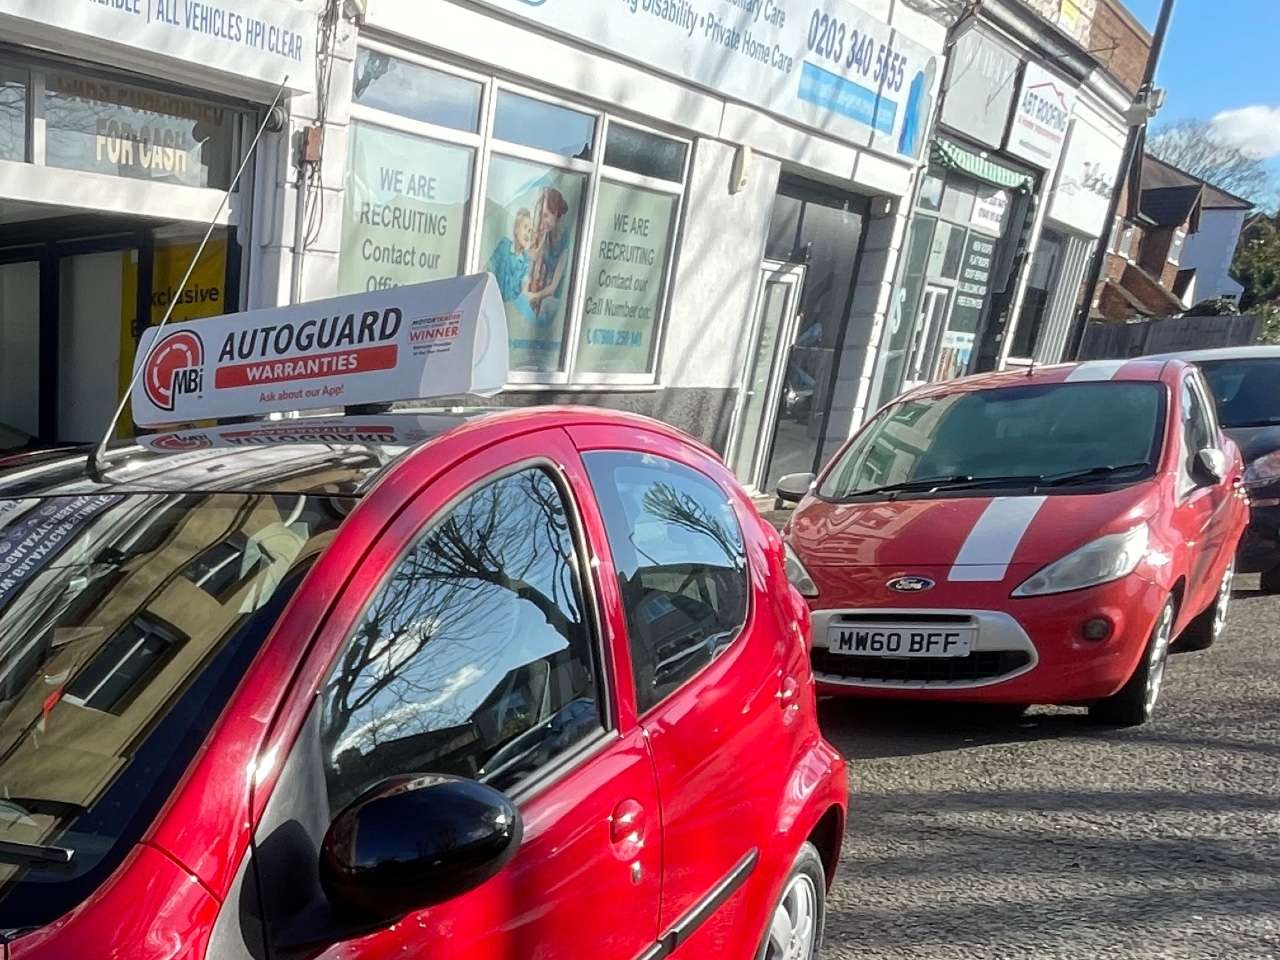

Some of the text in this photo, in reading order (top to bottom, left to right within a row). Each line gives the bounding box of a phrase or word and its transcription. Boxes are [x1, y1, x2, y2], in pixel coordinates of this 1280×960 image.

[157, 0, 180, 25] ALL
[185, 1, 242, 43] VEHICLES
[246, 18, 266, 50] HPI
[268, 26, 303, 61] CLEAR
[705, 12, 741, 51] Private
[741, 30, 771, 65] Home
[771, 44, 793, 74] Care
[807, 8, 846, 63] 0203
[846, 29, 874, 77] 340
[96, 119, 186, 172] FOR CASH
[379, 167, 437, 199] WE ARE
[360, 202, 448, 236] RECRUITING
[613, 213, 650, 237] WE ARE
[362, 238, 441, 270] Contact our
[599, 240, 655, 266] RECRUITING
[598, 269, 632, 291] Contact
[219, 307, 402, 363] AUTOGUARD
[410, 326, 459, 341] WINNER
[246, 355, 359, 381] WARRANTIES
[259, 384, 345, 402] Ask about our App!
[838, 631, 961, 654] MW60 BFF
